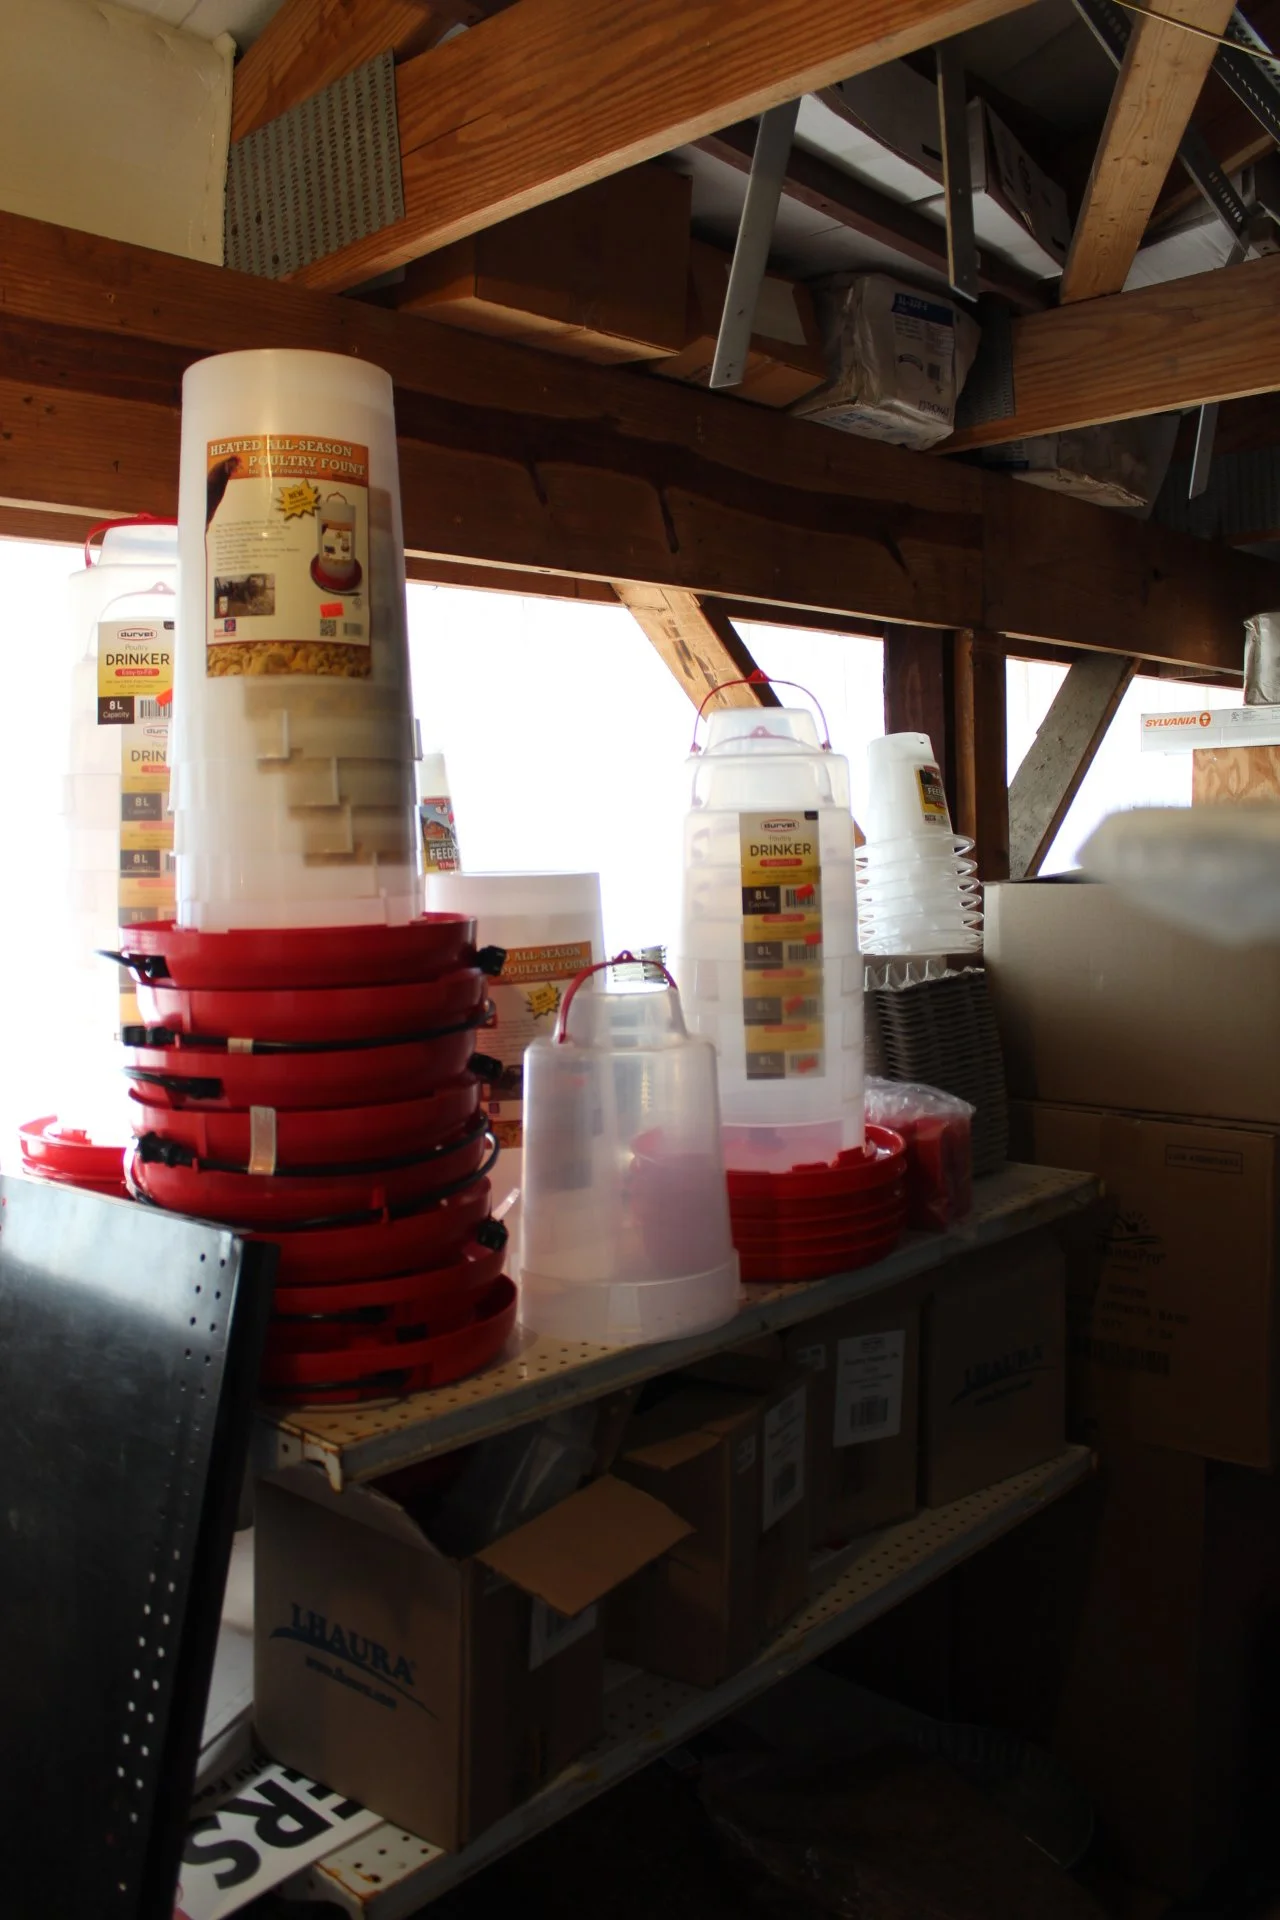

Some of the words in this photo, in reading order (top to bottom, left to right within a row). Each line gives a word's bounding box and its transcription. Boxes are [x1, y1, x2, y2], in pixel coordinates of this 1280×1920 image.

[210, 440, 262, 456] HEATED
[266, 440, 353, 457] ALL-SEASON
[249, 455, 316, 468] POULTRY
[320, 458, 365, 476] FOUNT
[288, 489, 304, 499] NEW
[106, 653, 170, 666] DRINKER
[109, 701, 116, 710] 8
[117, 701, 123, 710] L
[103, 711, 129, 719] Capacity
[1145, 716, 1197, 727] SYLVANIA
[131, 750, 166, 762] DRIN
[750, 843, 812, 857] DRINKER
[501, 962, 555, 976] POULTRY
